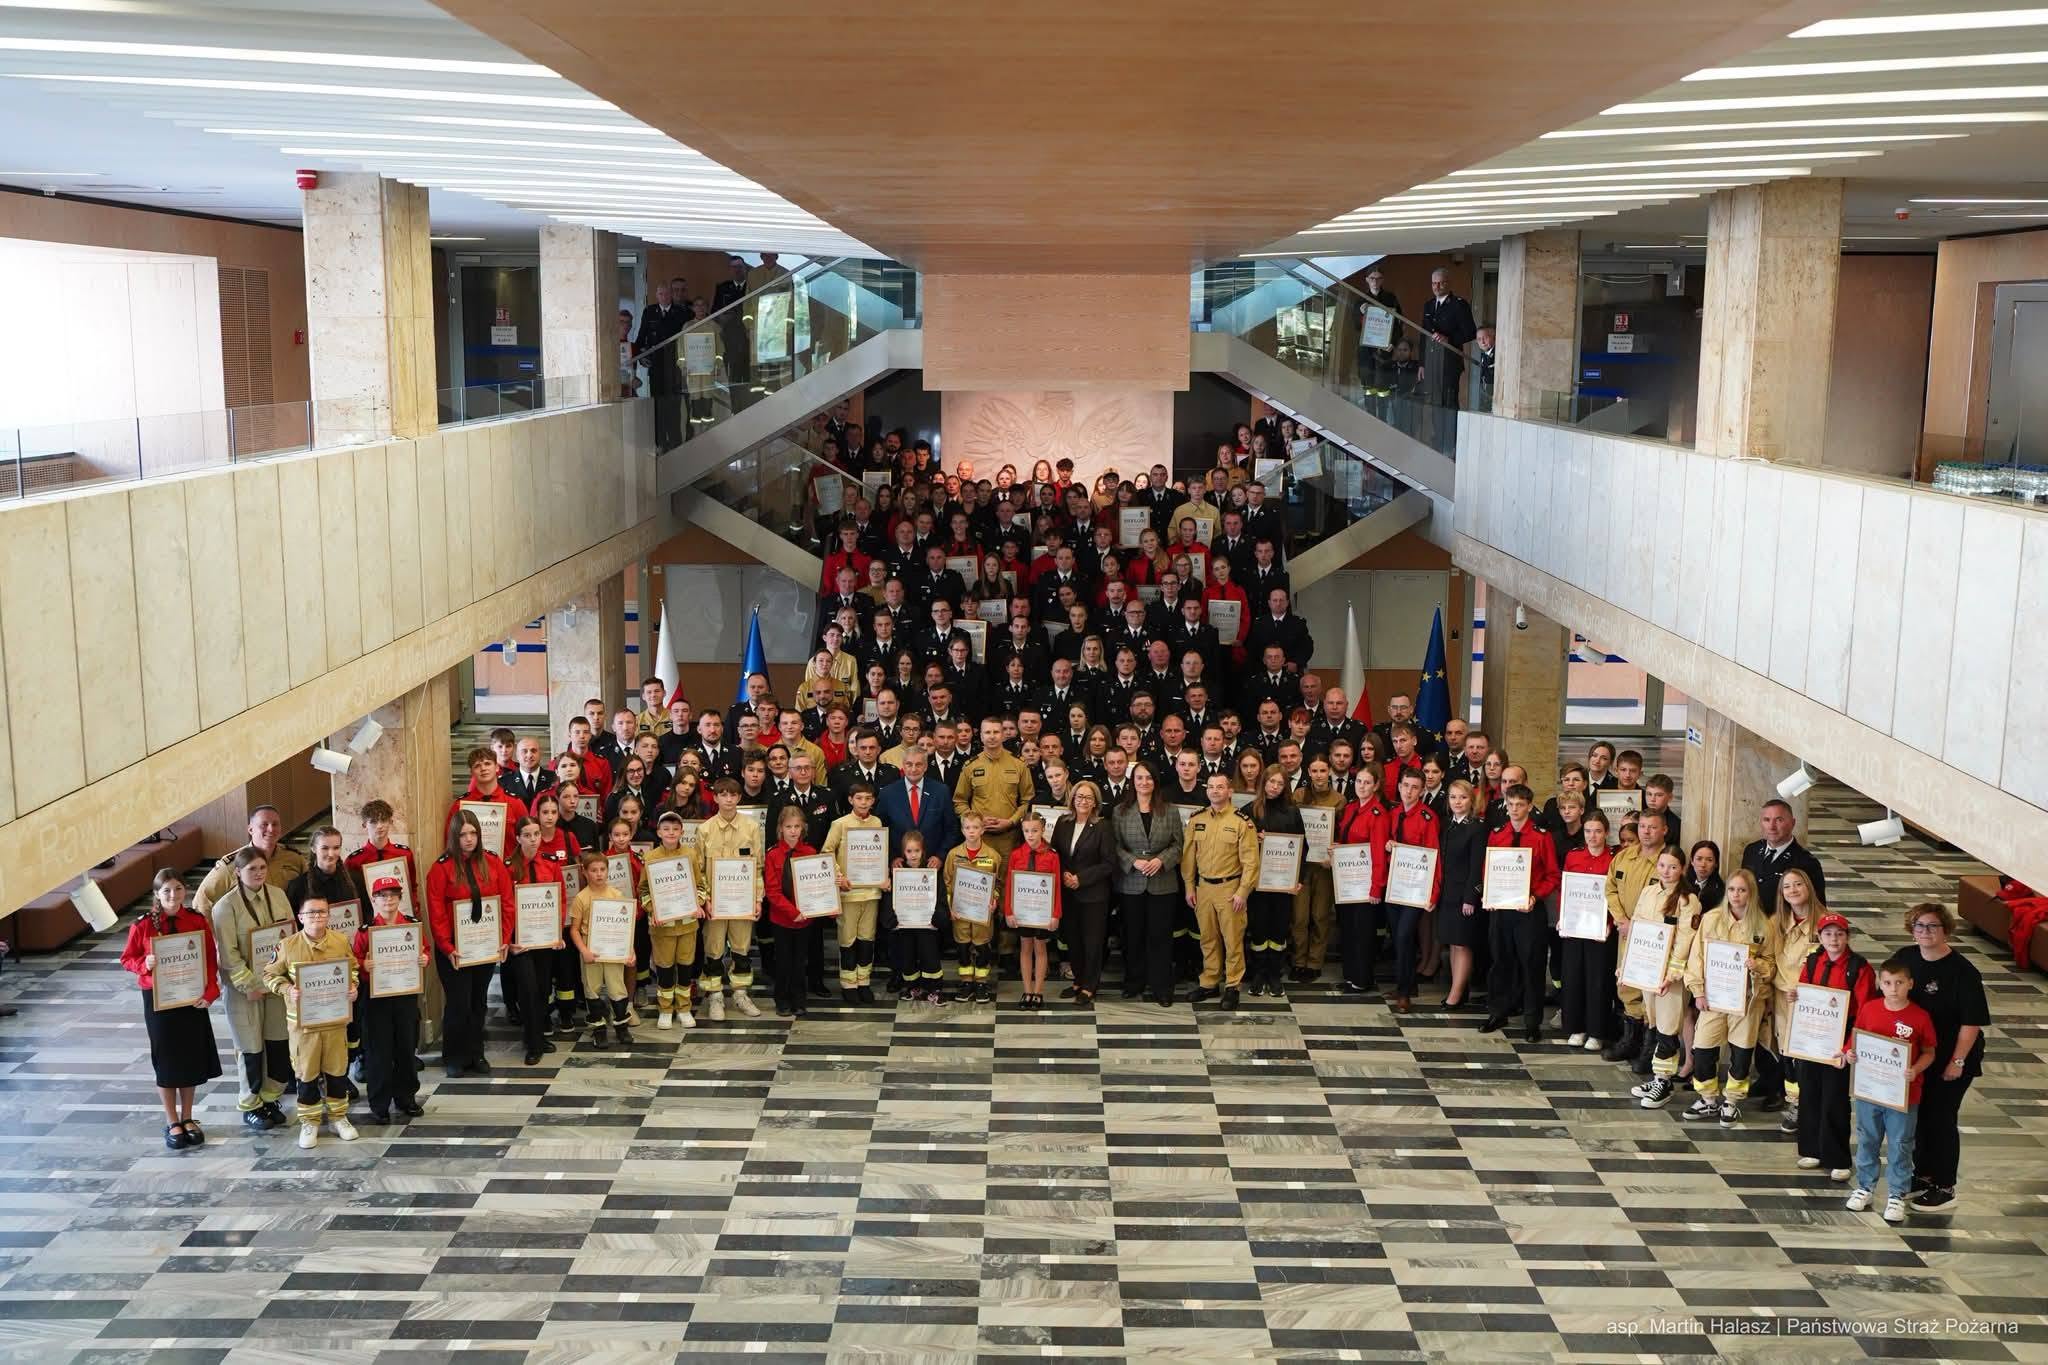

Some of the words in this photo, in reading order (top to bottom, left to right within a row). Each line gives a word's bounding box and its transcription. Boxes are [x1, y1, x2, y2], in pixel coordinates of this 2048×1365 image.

[1338, 860, 1369, 868] DYPLOM
[1396, 861, 1429, 872] DYPLOM
[655, 873, 688, 885] DYPLOM
[800, 872, 832, 881] DYPLOM
[958, 880, 989, 894] DYPLOM
[1017, 887, 1049, 895] DYPLOM
[1568, 889, 1602, 900] DYPLOM
[521, 902, 555, 910] DYPLOM
[461, 915, 495, 926] DYOM
[595, 915, 629, 924] DYPLOM
[325, 921, 355, 931] YPLOM
[377, 944, 416, 954] DYPLOM
[1633, 937, 1665, 951] DYPLOM
[160, 952, 199, 965] DYPLOM
[1710, 959, 1743, 972] DYPLOM
[304, 977, 345, 989] DYPLOM
[1798, 1004, 1840, 1019] DYPLOM
[1859, 1050, 1903, 1069] DYPLOM
